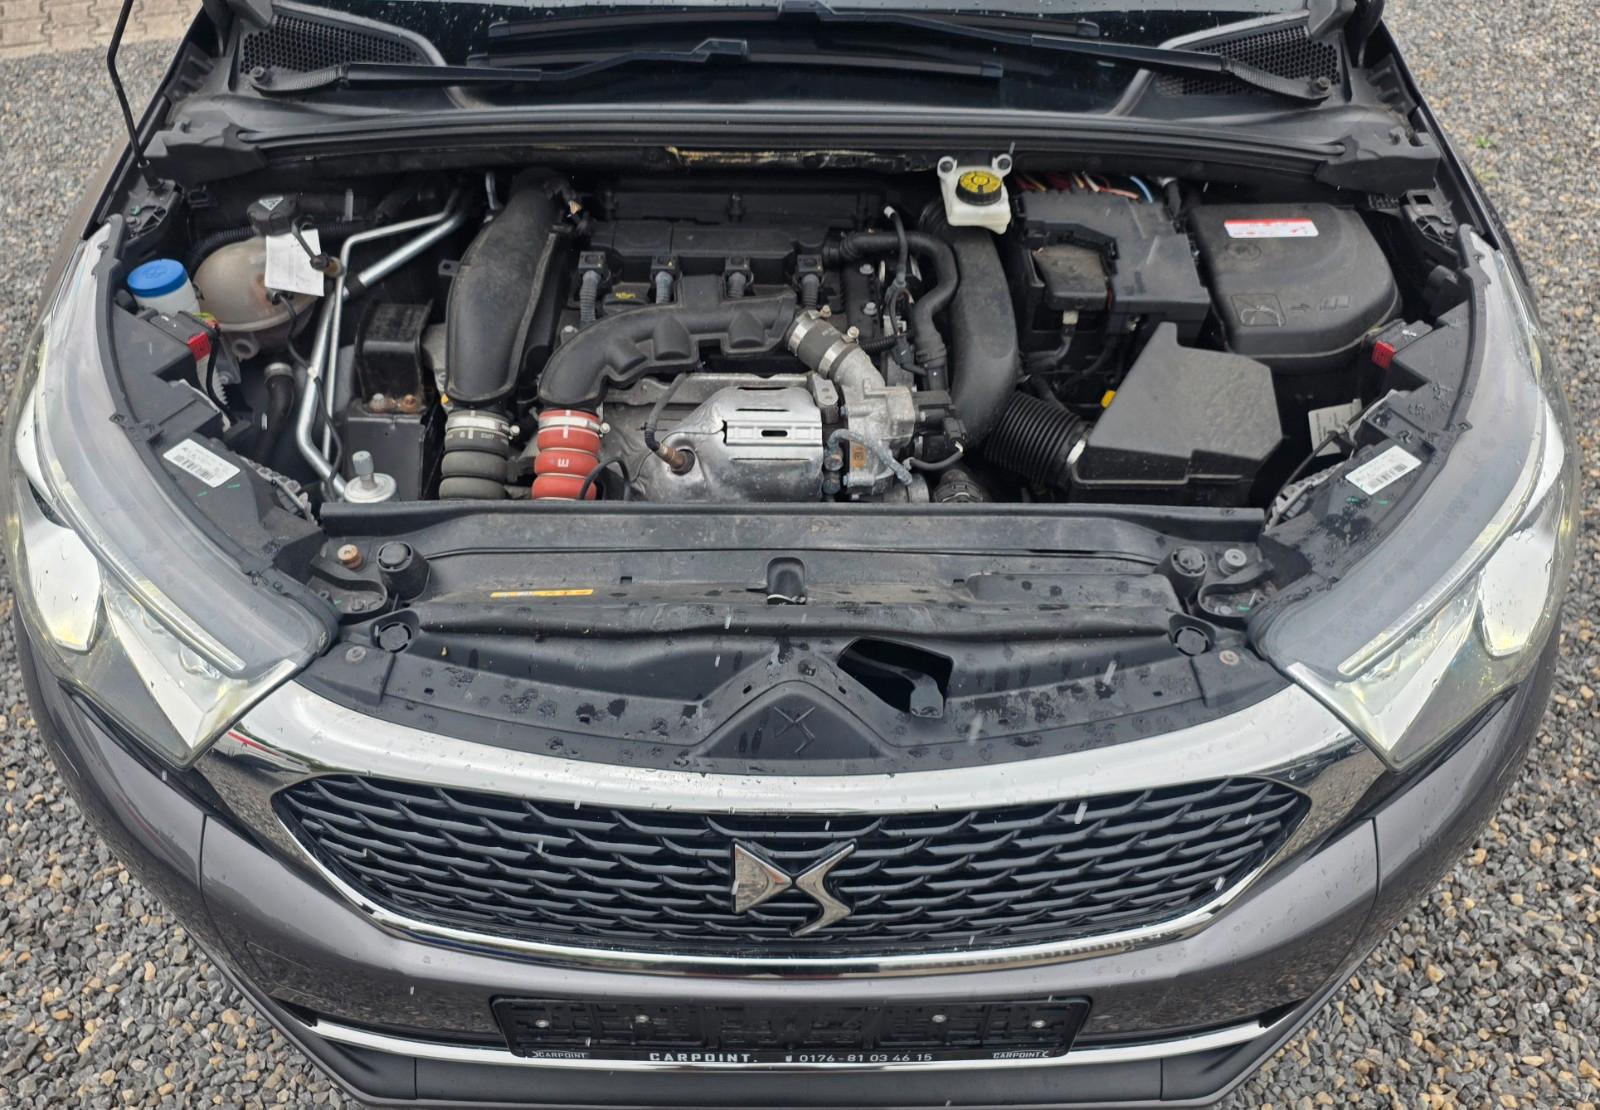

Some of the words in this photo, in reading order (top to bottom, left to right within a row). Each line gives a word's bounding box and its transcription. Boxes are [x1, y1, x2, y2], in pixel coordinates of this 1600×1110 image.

[869, 1054, 888, 1062] 03
[892, 1054, 911, 1062] 46
[917, 1053, 933, 1061] 15
